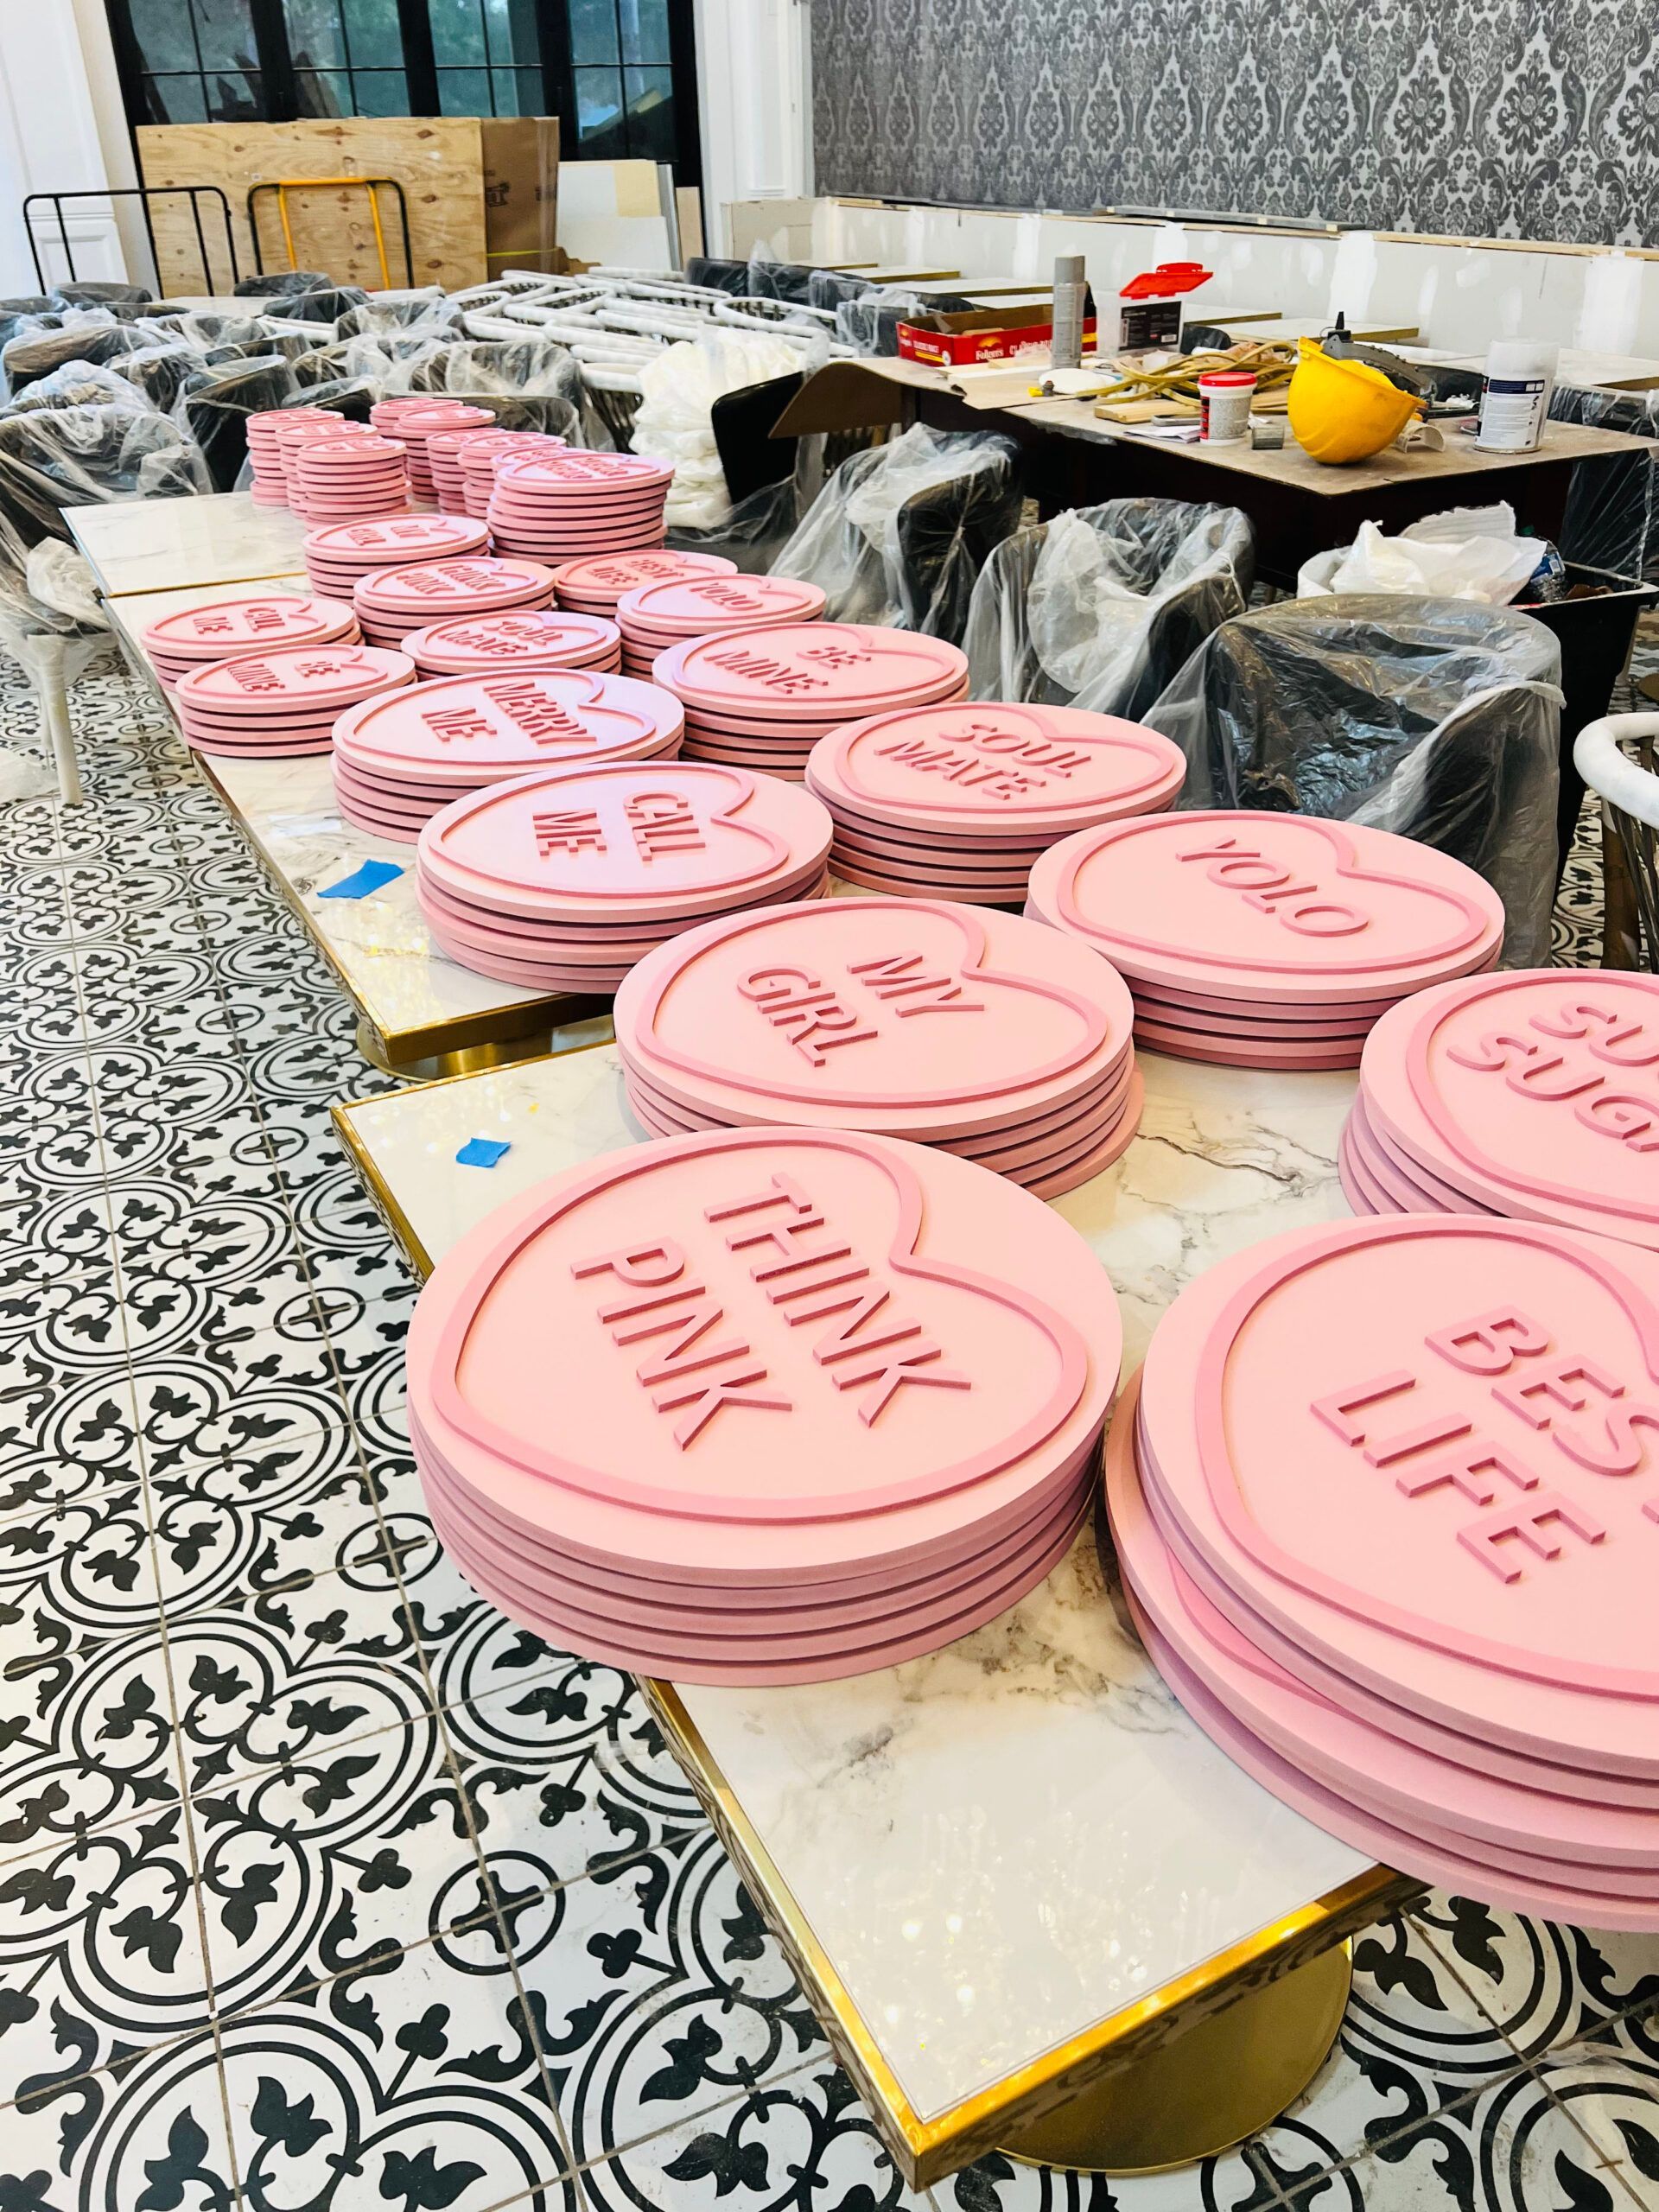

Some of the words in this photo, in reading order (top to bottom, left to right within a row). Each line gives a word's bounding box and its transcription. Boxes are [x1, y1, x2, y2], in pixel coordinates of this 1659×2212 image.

[391, 524, 429, 538] MY
[396, 572, 456, 595] PINK
[438, 564, 506, 591] THINK
[587, 566, 639, 585] LIFE
[624, 559, 685, 579] BEST
[690, 582, 764, 612] YOLO
[193, 616, 234, 635] ME
[241, 607, 286, 632] CALL
[482, 619, 563, 647] SOUL
[438, 630, 528, 655] MATE
[797, 643, 872, 671] BE
[227, 663, 285, 693] MINE
[295, 659, 342, 678] BE
[702, 648, 829, 694] MINE
[421, 705, 498, 743] ME
[481, 681, 597, 746] MERRY
[873, 737, 1047, 801] MATE
[938, 720, 1092, 780] SOUL
[531, 808, 607, 857] ME
[622, 790, 706, 861] CALL
[1175, 834, 1370, 938] YOLO
[846, 950, 985, 1019] MY
[735, 962, 880, 1068] GIRL
[1529, 998, 1659, 1084] SU
[703, 1171, 972, 1429] THINK
[569, 1235, 793, 1452] PINK
[1424, 1303, 1659, 1523] BES
[1310, 1369, 1607, 1586] LIFE
